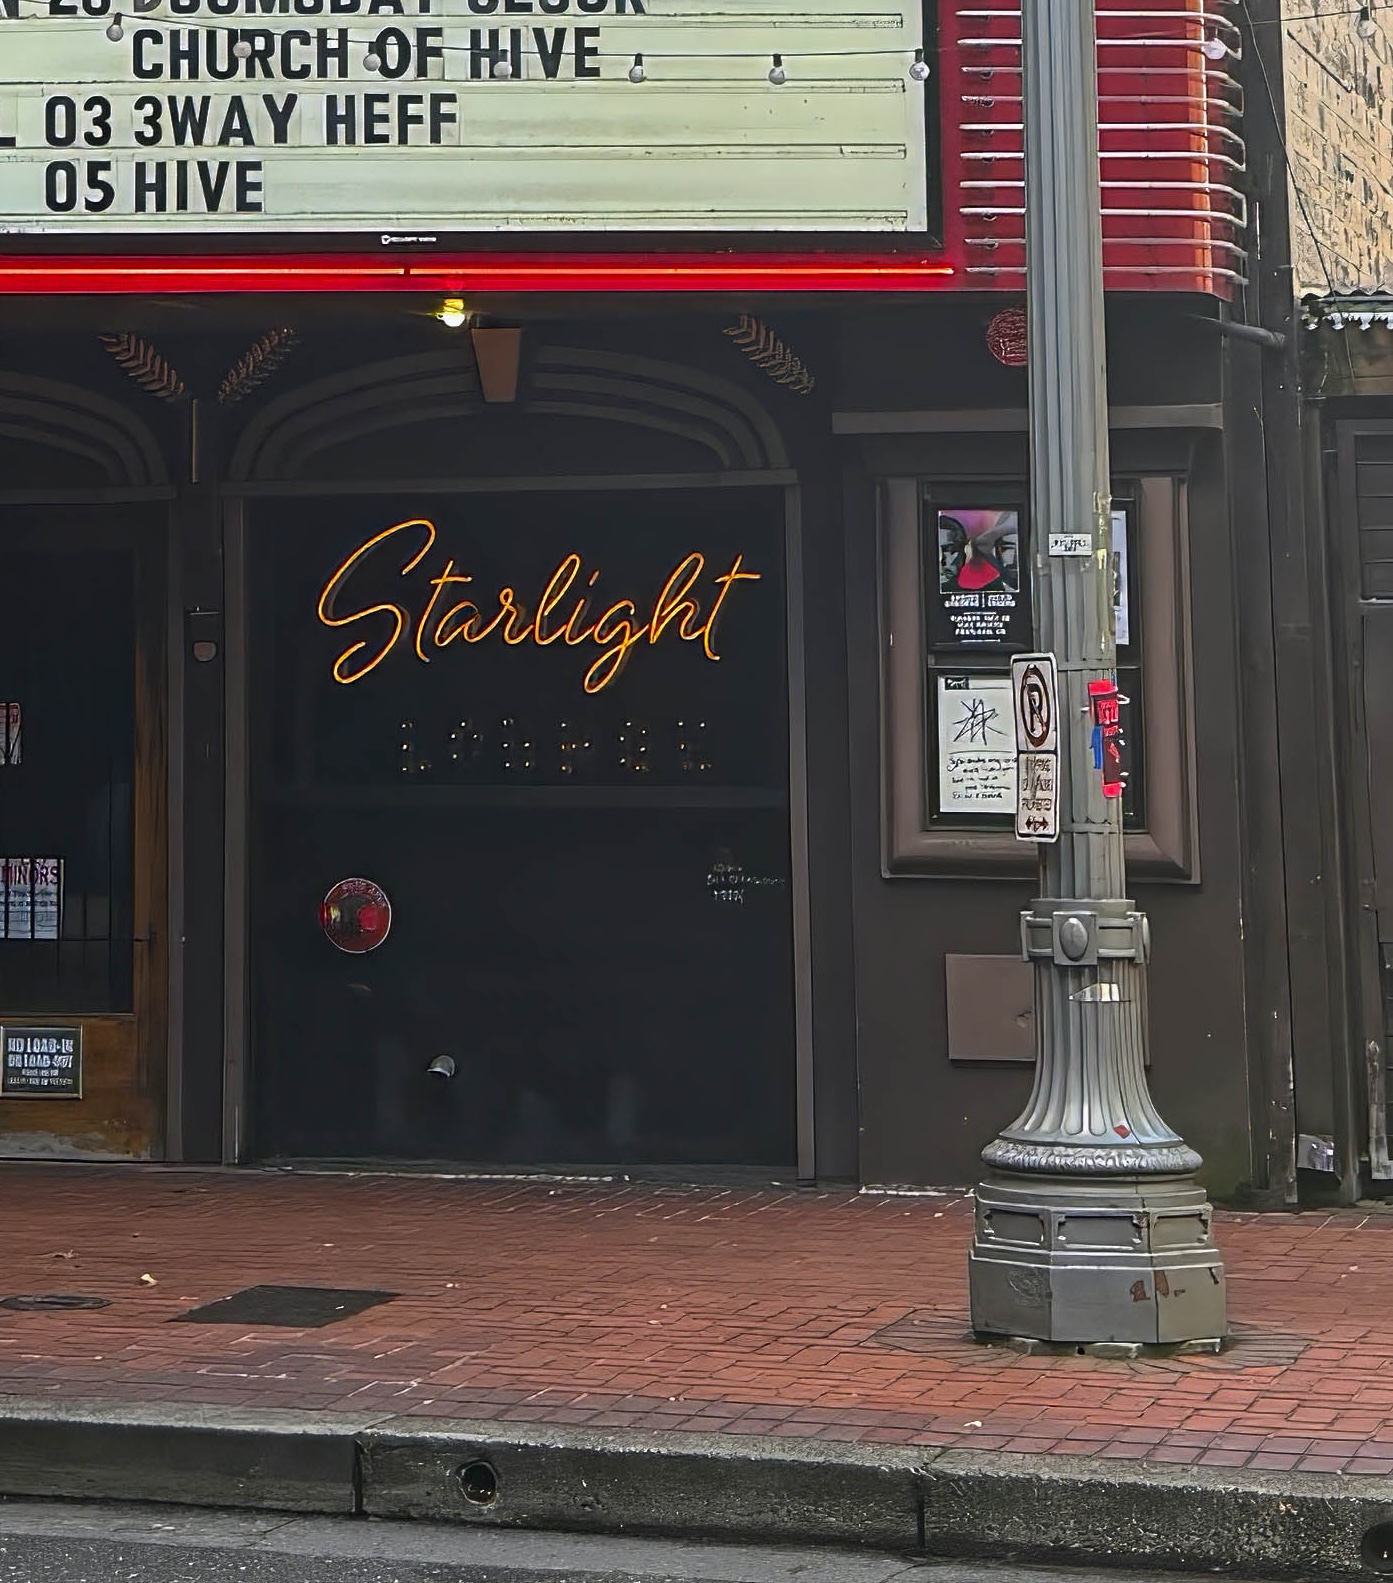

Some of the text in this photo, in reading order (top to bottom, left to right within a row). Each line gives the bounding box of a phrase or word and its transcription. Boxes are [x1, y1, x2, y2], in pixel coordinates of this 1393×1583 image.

[131, 26, 601, 81] CHURCH OF HIVE
[44, 94, 111, 148] 03
[133, 93, 299, 146] 3WAY
[325, 92, 459, 145] HEFF
[44, 160, 263, 213] 05 HIVE
[318, 518, 760, 694] Starlight
